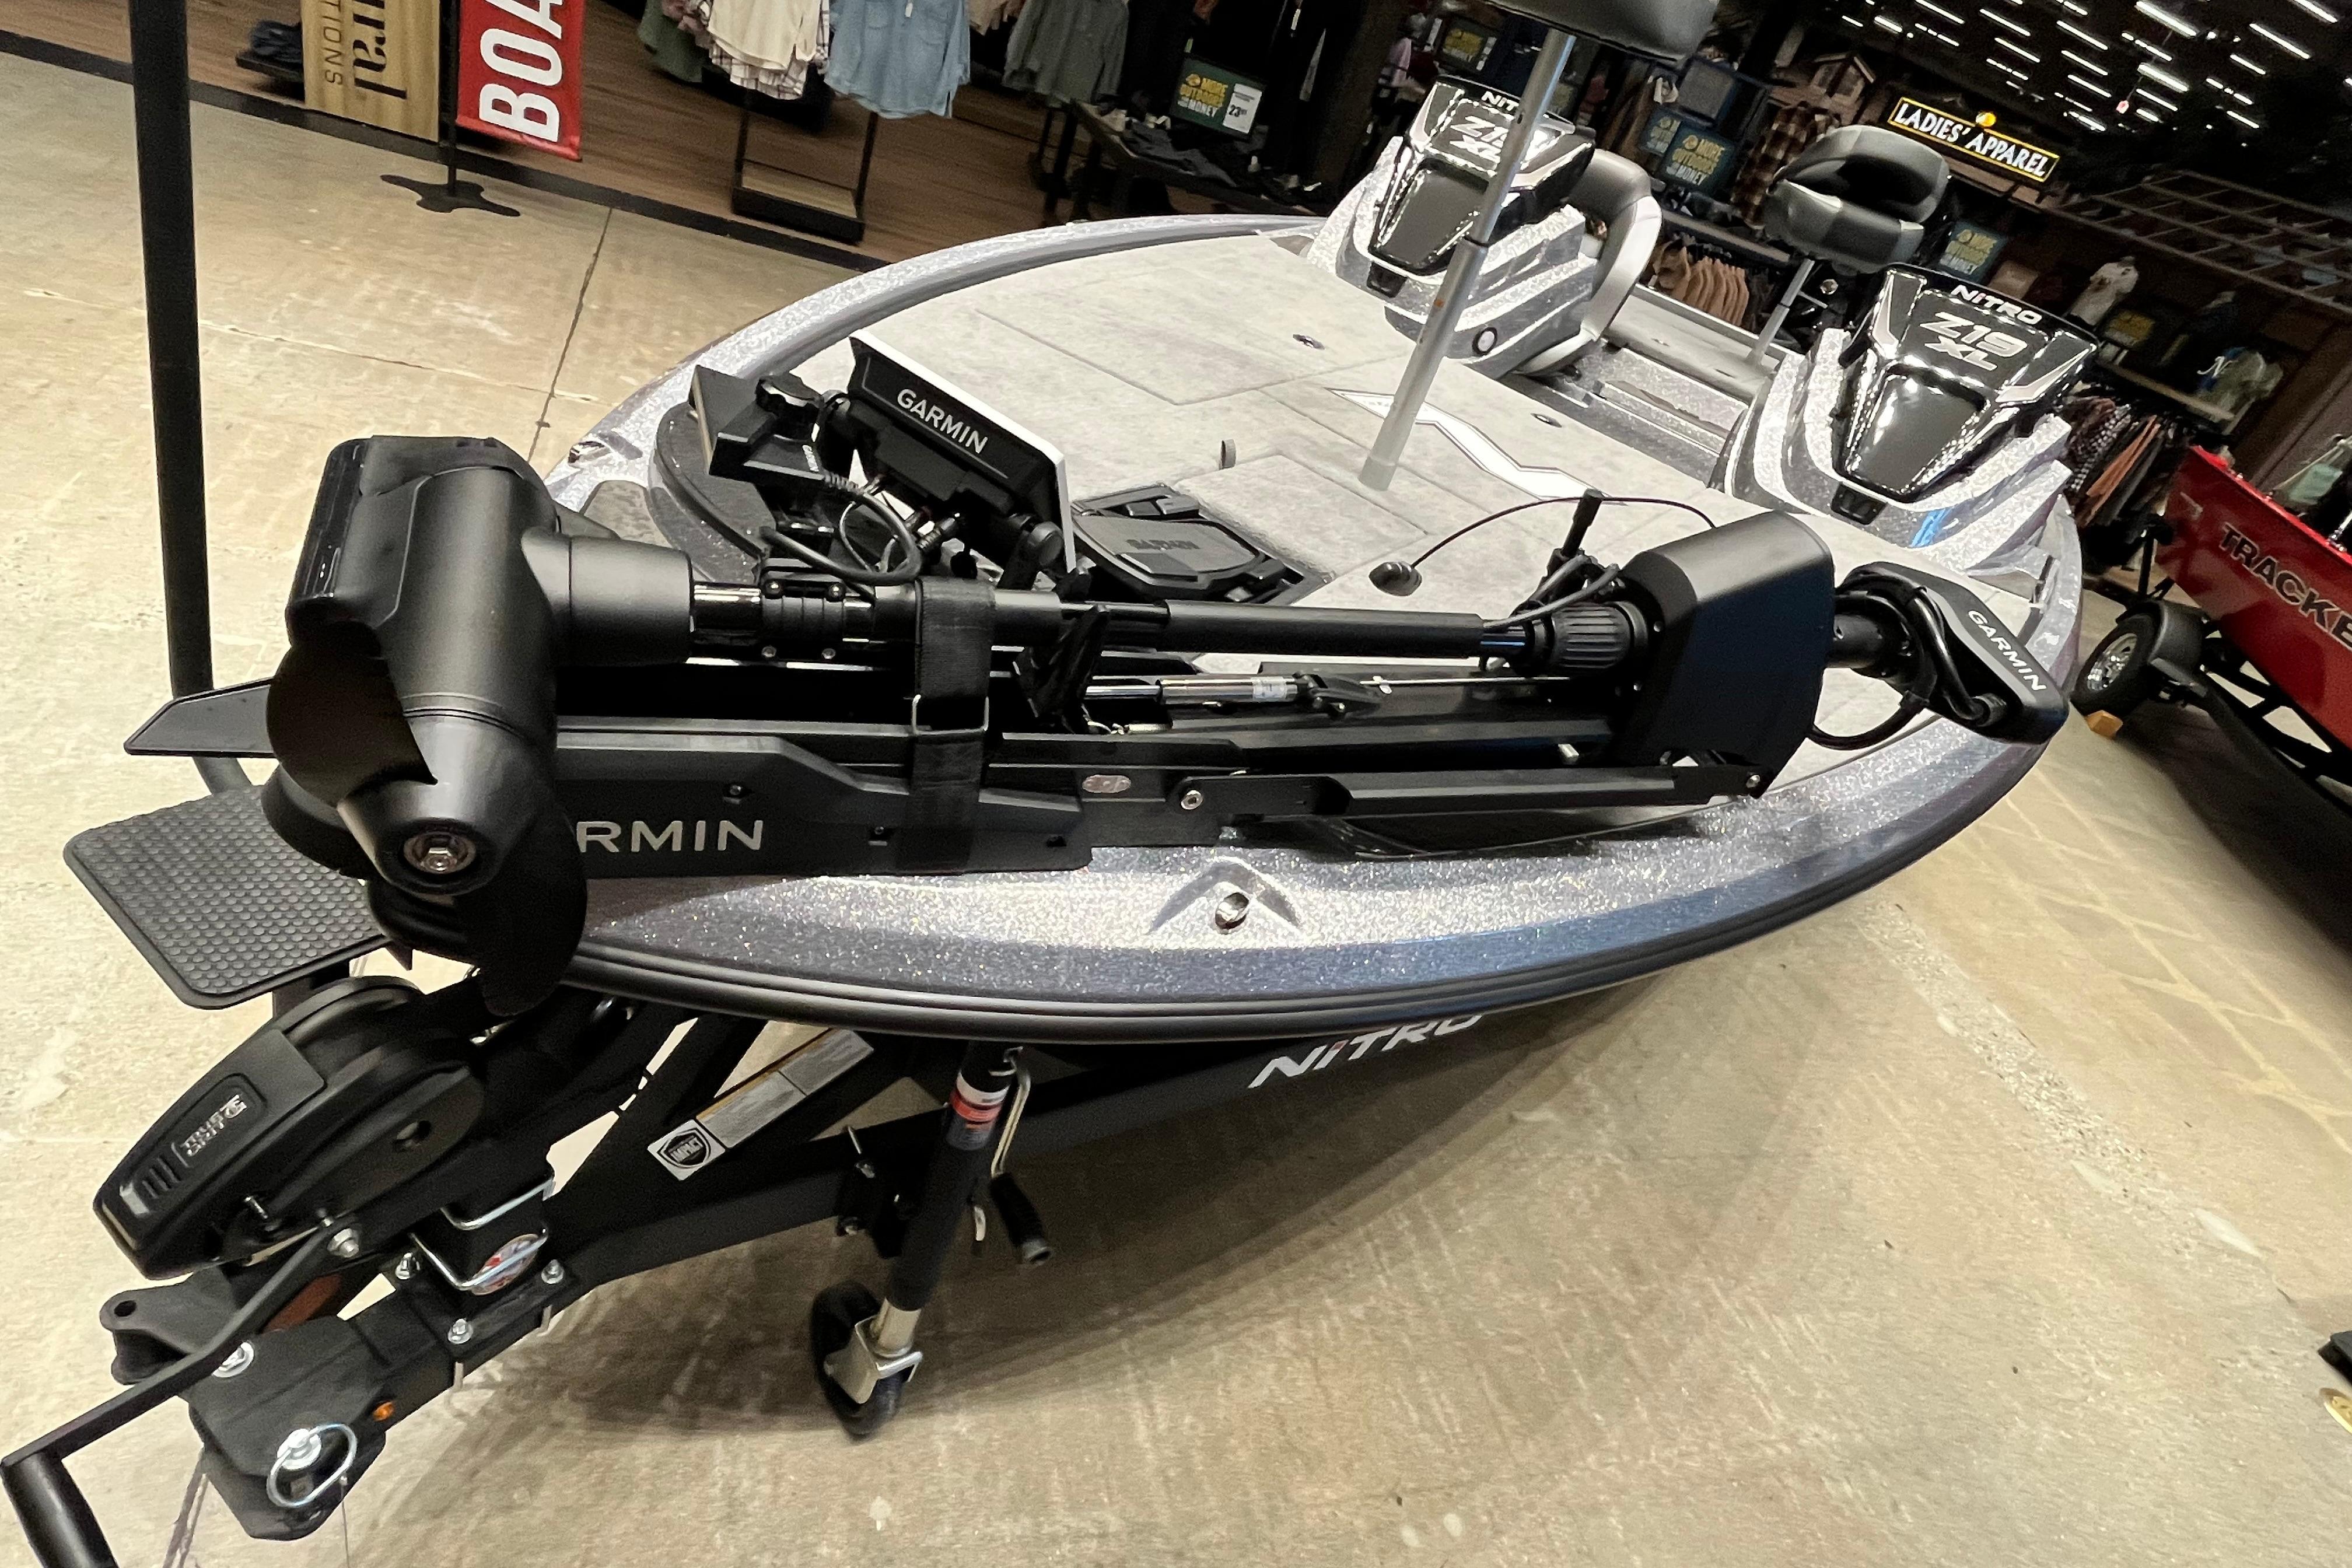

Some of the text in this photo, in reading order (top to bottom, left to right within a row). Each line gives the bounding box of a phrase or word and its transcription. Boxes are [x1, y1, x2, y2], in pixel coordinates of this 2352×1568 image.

[1480, 91, 1520, 111] NIT
[1450, 116, 1509, 149] Z1
[1894, 103, 2049, 177] LADIES' APPAREL
[1919, 312, 2028, 358] Z19
[1924, 335, 1998, 372] XL
[897, 388, 989, 454] GARMIN
[1968, 610, 2047, 691] GARMIN
[576, 820, 763, 853] RMIN
